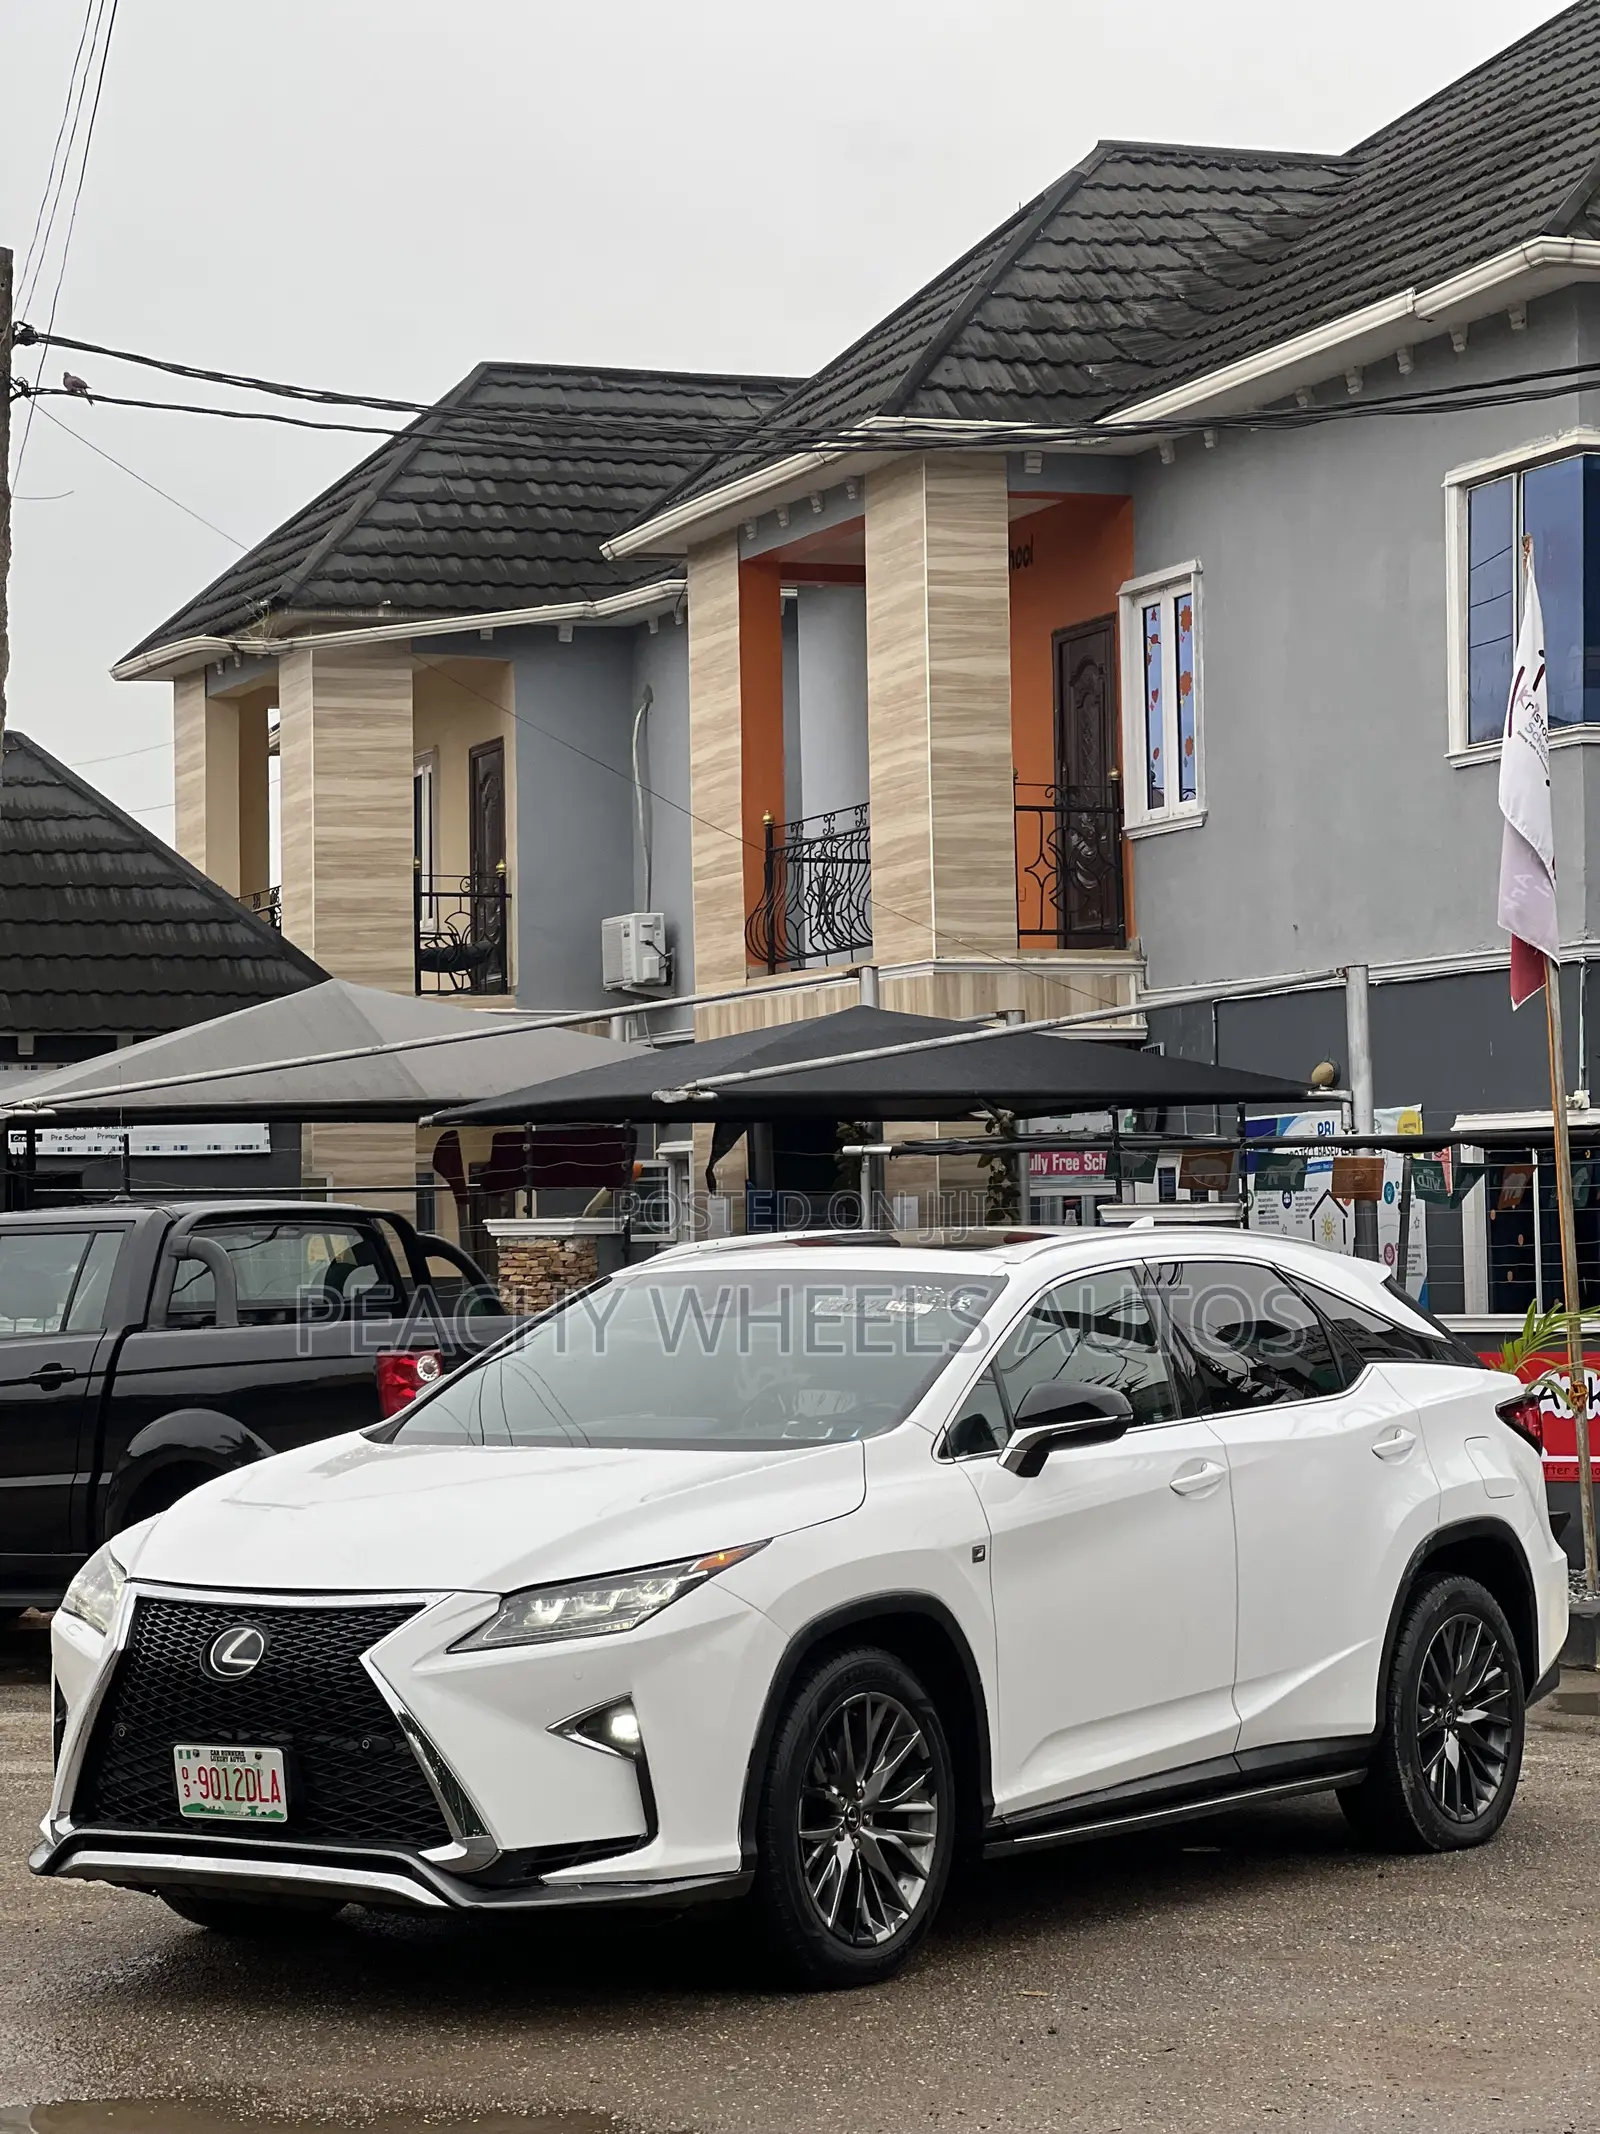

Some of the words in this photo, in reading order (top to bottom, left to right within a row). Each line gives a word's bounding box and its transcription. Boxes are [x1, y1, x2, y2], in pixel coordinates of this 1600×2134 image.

[64, 1133, 86, 1141] School
[1052, 1153, 1080, 1171] Free
[1084, 1153, 1106, 1171] Sch
[1545, 1463, 1570, 1475] fter
